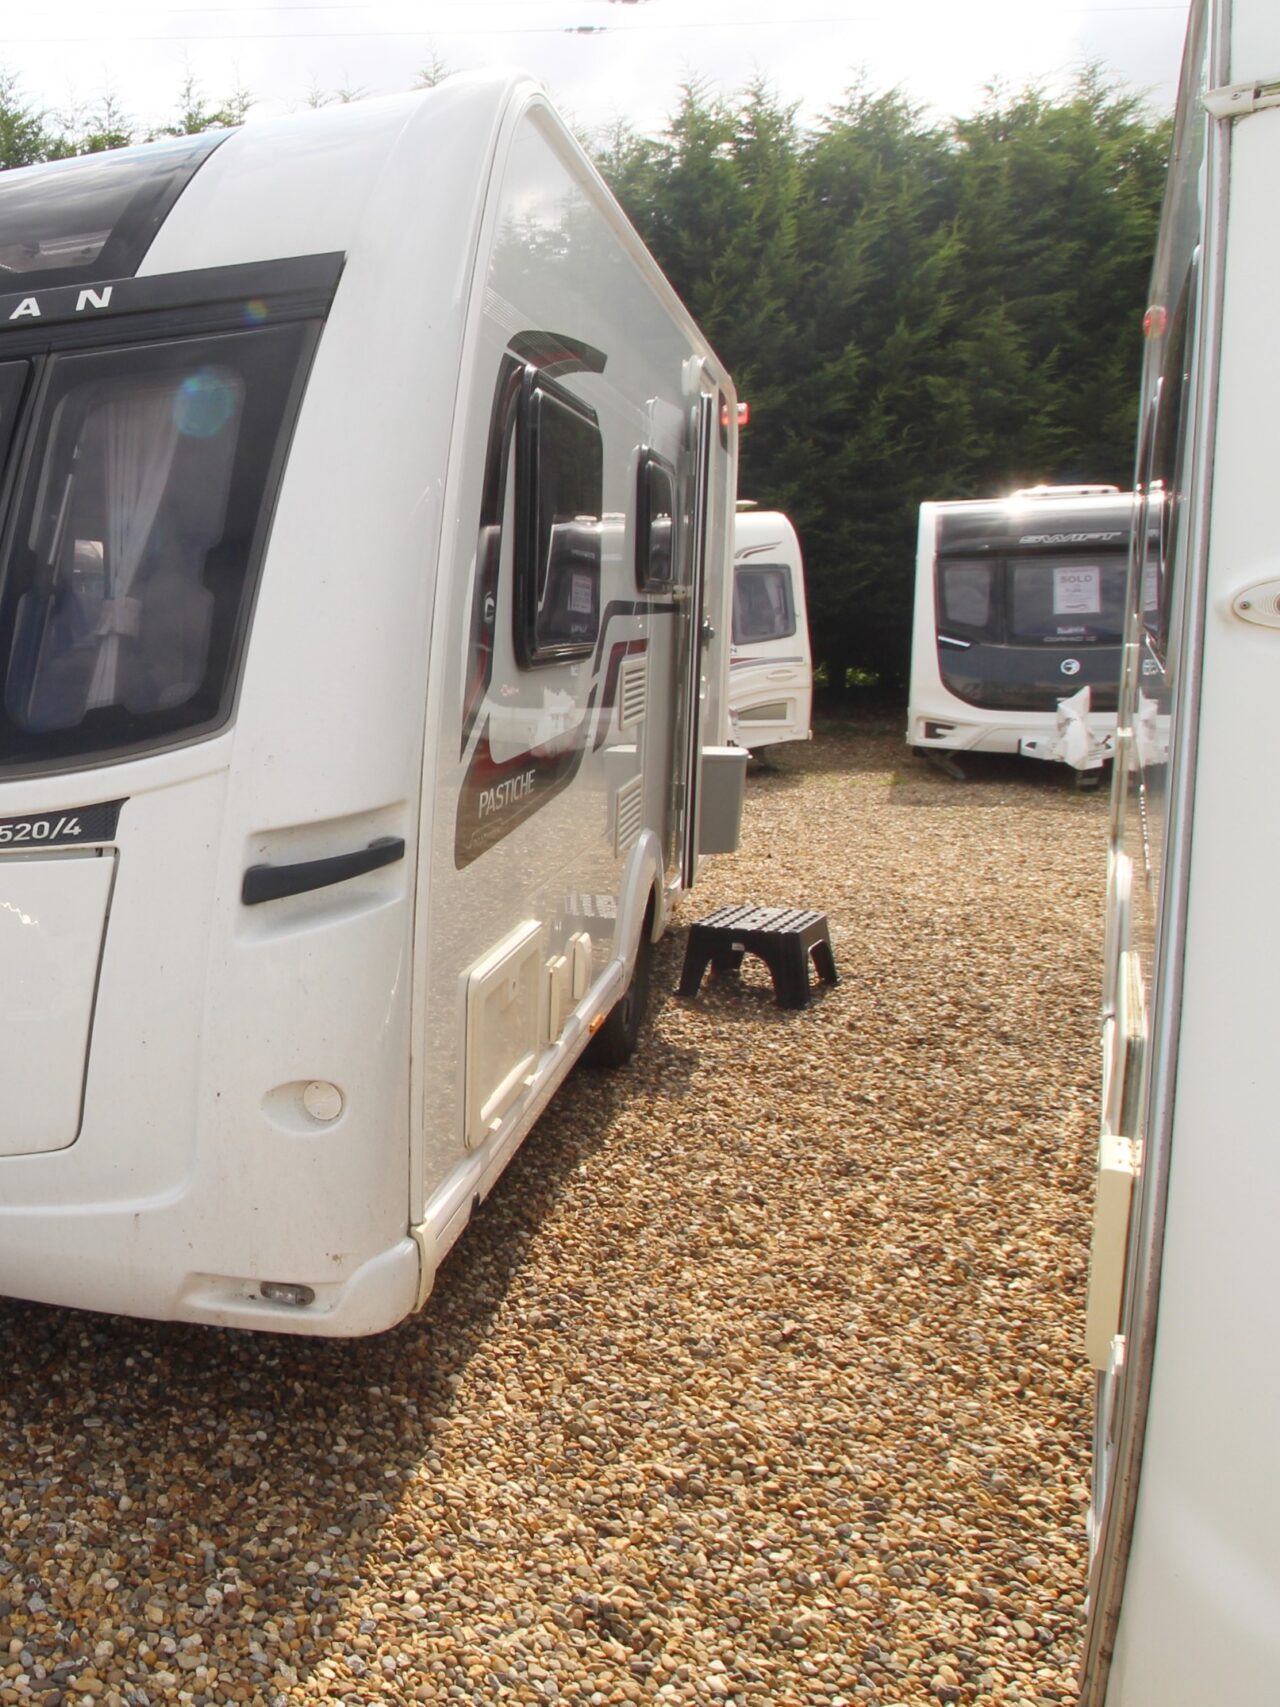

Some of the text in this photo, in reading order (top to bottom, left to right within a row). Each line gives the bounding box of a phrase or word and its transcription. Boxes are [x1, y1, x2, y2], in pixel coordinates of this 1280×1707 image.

[1019, 531, 1123, 544] SWIFT
[1060, 575, 1093, 583] SOLD
[478, 769, 536, 819] PASTICHE
